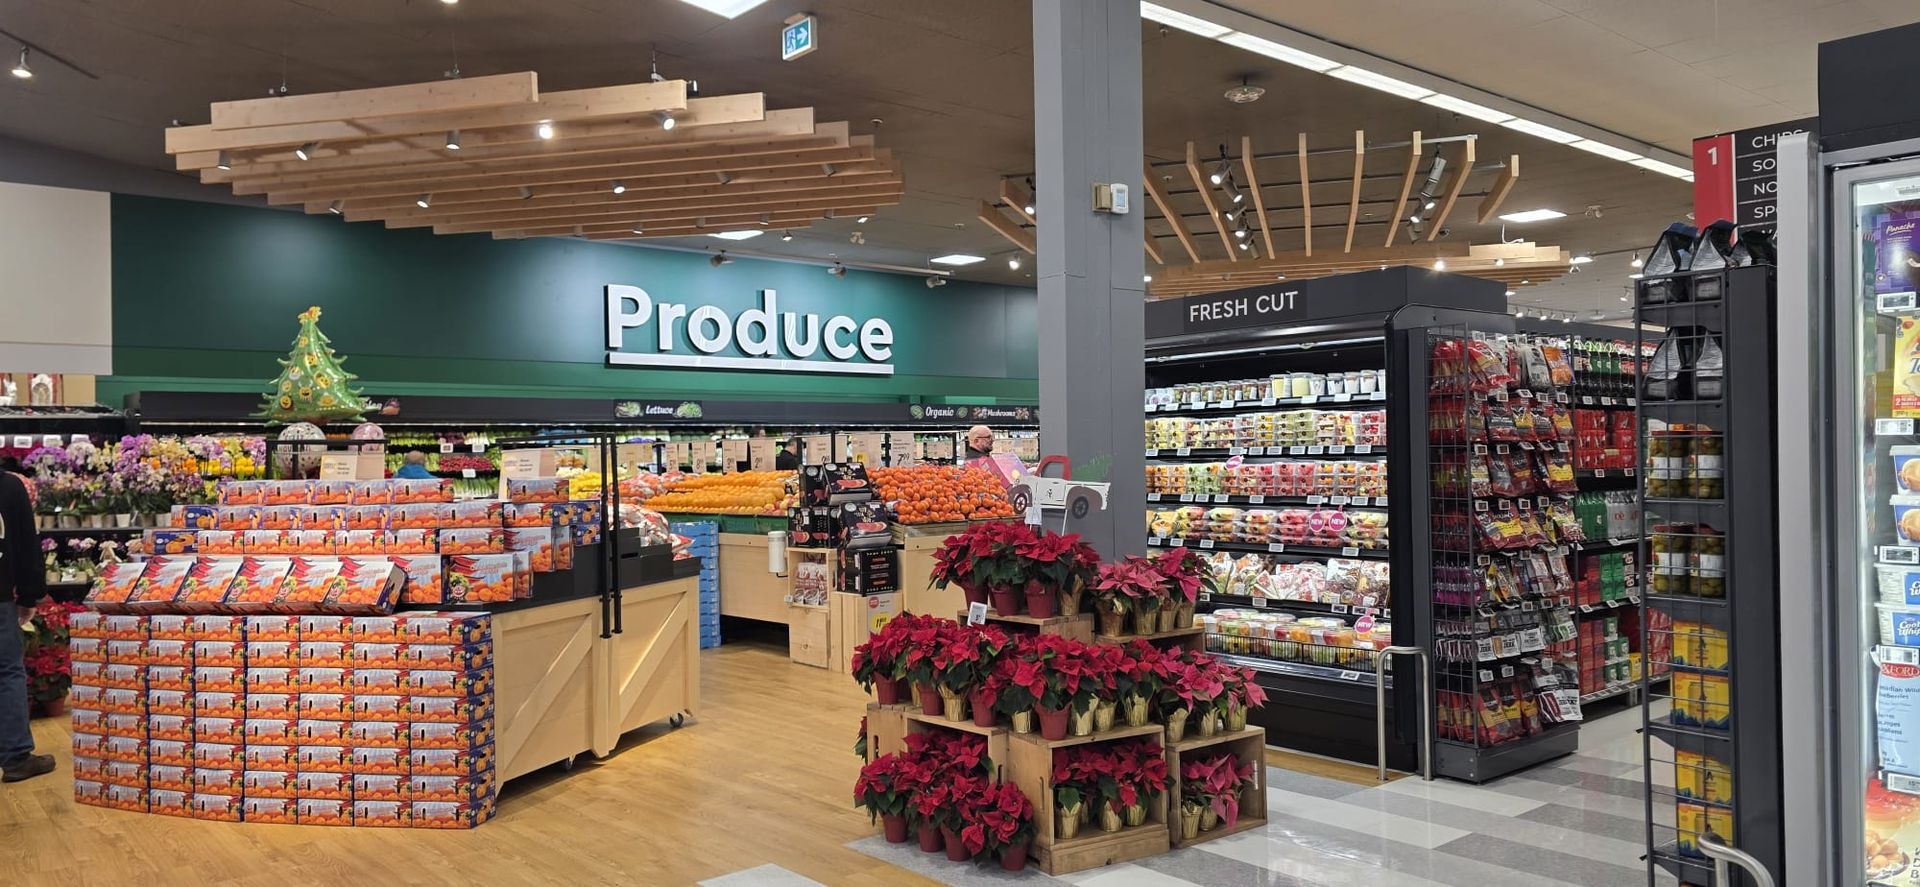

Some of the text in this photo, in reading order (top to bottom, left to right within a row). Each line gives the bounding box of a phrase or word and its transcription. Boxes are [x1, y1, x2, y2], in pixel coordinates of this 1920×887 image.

[1707, 147, 1719, 166] 1
[1754, 205, 1777, 219] SP
[1189, 291, 1299, 322] FRESH CUT
[606, 284, 894, 362] Produce
[645, 405, 674, 414] Lettuce
[925, 406, 954, 419] Organic
[987, 409, 1016, 417] Mushrooms
